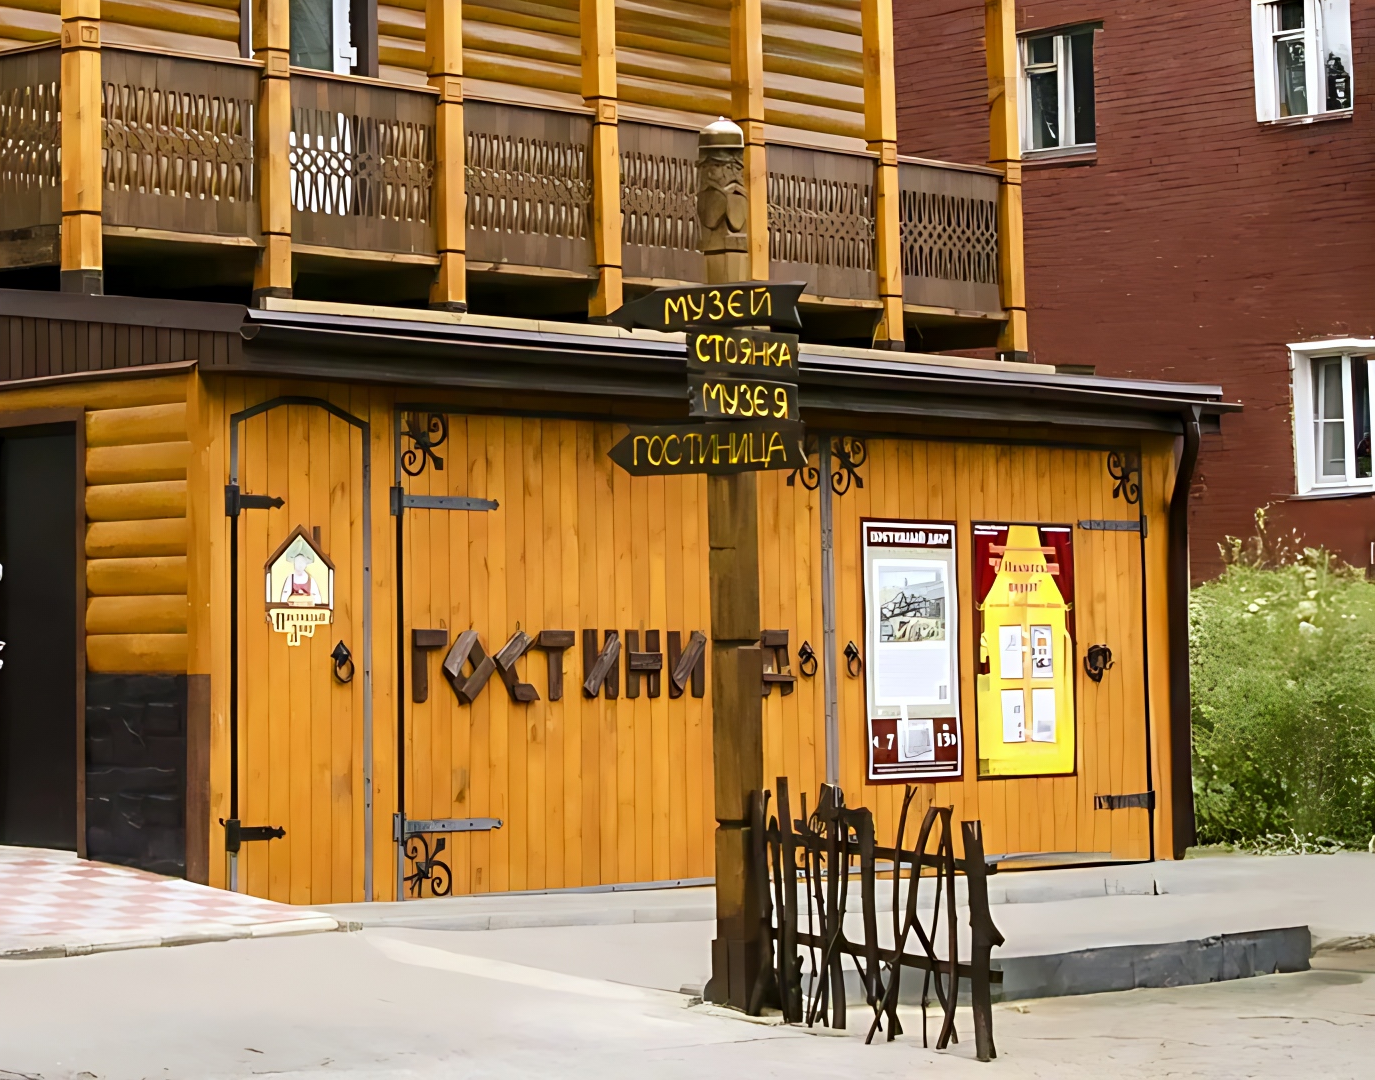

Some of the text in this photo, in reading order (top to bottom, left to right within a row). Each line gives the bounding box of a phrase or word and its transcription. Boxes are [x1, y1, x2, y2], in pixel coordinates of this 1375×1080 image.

[663, 286, 773, 325] МУЗЕЙ
[695, 333, 793, 369] СТОЯНКА
[702, 382, 789, 419] МУЗЕЯ
[632, 431, 788, 468] ГОСТИНИЦА
[411, 628, 798, 706] ГОСТИНИА
